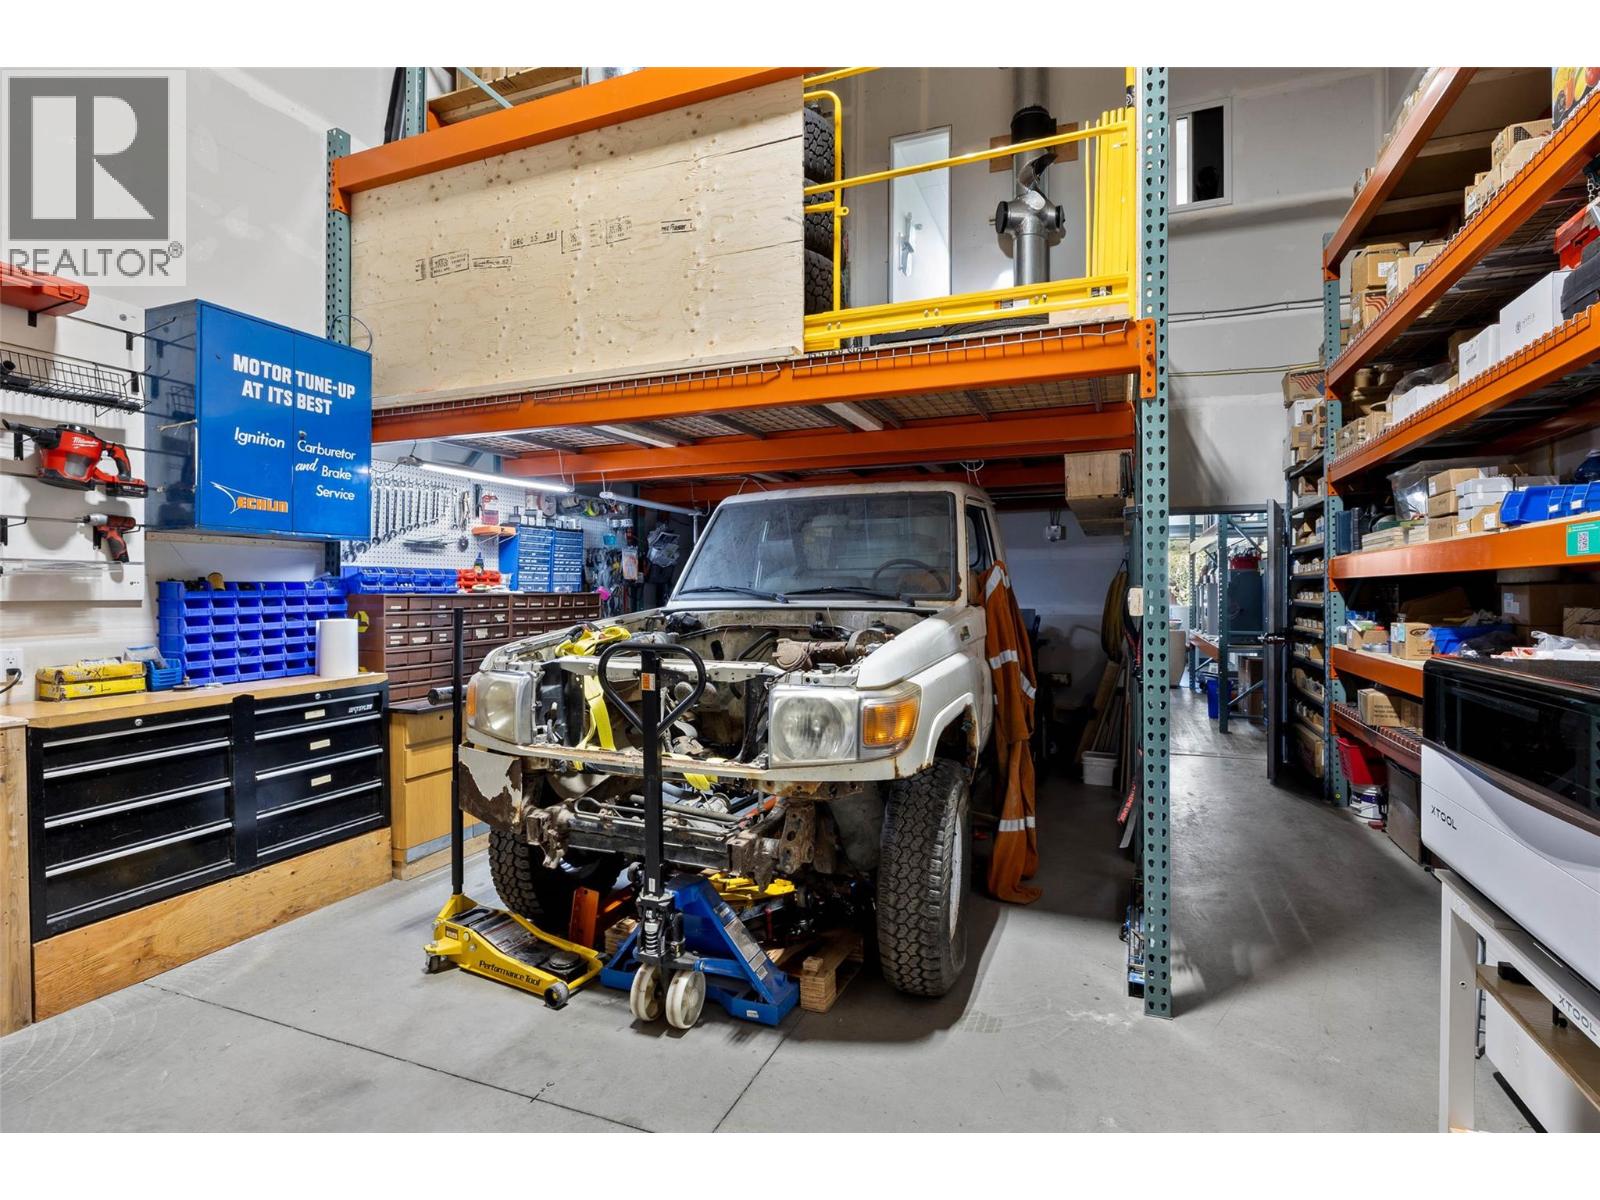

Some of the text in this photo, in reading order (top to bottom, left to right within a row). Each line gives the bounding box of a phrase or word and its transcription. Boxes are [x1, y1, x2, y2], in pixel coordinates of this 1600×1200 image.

[233, 353, 356, 399] MOTOR TUNE-UP
[241, 379, 333, 416] AT ITS BEST
[234, 426, 286, 449] Ignition
[297, 439, 357, 460] Carburetor
[295, 457, 352, 480] and Brake
[236, 496, 289, 514] ECHLIN
[315, 485, 356, 501] Service
[1431, 804, 1457, 830] XTOOL
[479, 959, 541, 986] Performance Tool
[1558, 992, 1598, 1037] XTOOL
